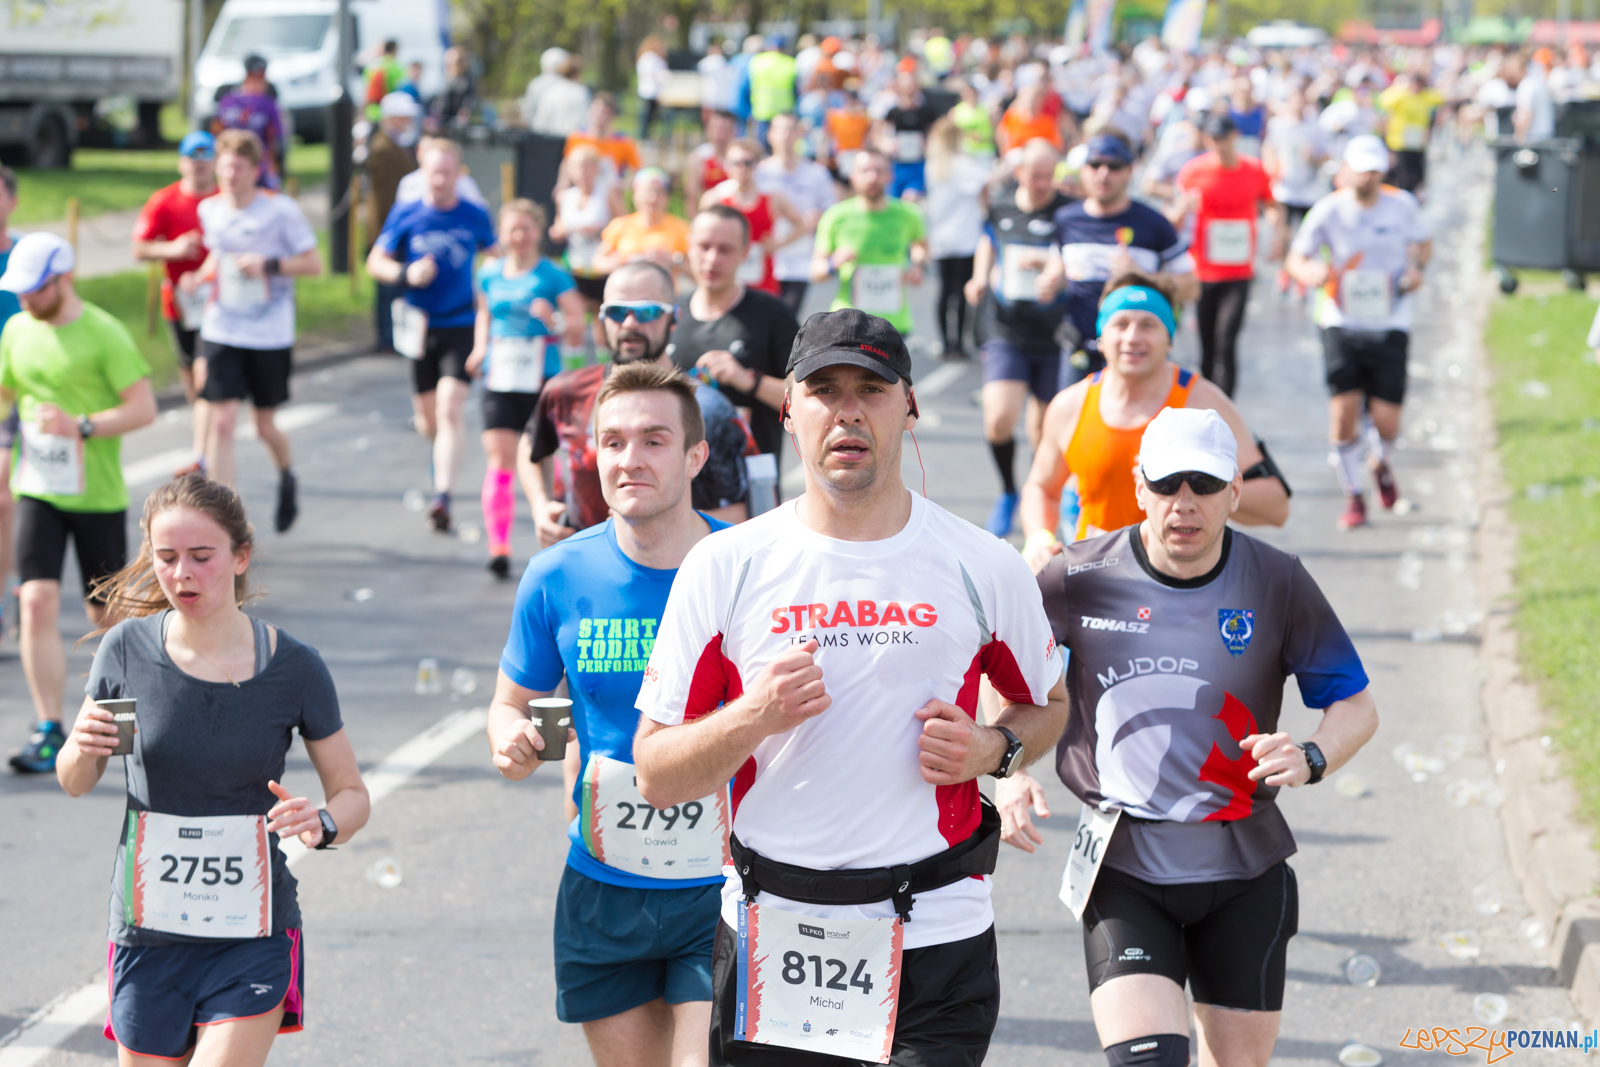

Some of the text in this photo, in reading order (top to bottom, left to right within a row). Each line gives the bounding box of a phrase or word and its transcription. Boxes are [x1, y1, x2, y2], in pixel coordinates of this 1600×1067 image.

[860, 344, 889, 360] STRABAG
[770, 600, 938, 634] STRABAG
[1081, 616, 1150, 634] TOMASZ
[578, 618, 657, 638] START
[857, 631, 919, 645] WORK.
[577, 639, 656, 659] TODAY
[1097, 656, 1199, 689] MJDOP
[616, 801, 704, 831] 2799
[645, 838, 677, 846] Dawid
[160, 854, 244, 886] 2755
[184, 892, 218, 901] Monika
[802, 926, 823, 937] 11.PKO
[782, 950, 874, 995] 8124
[810, 996, 844, 1010] Michal
